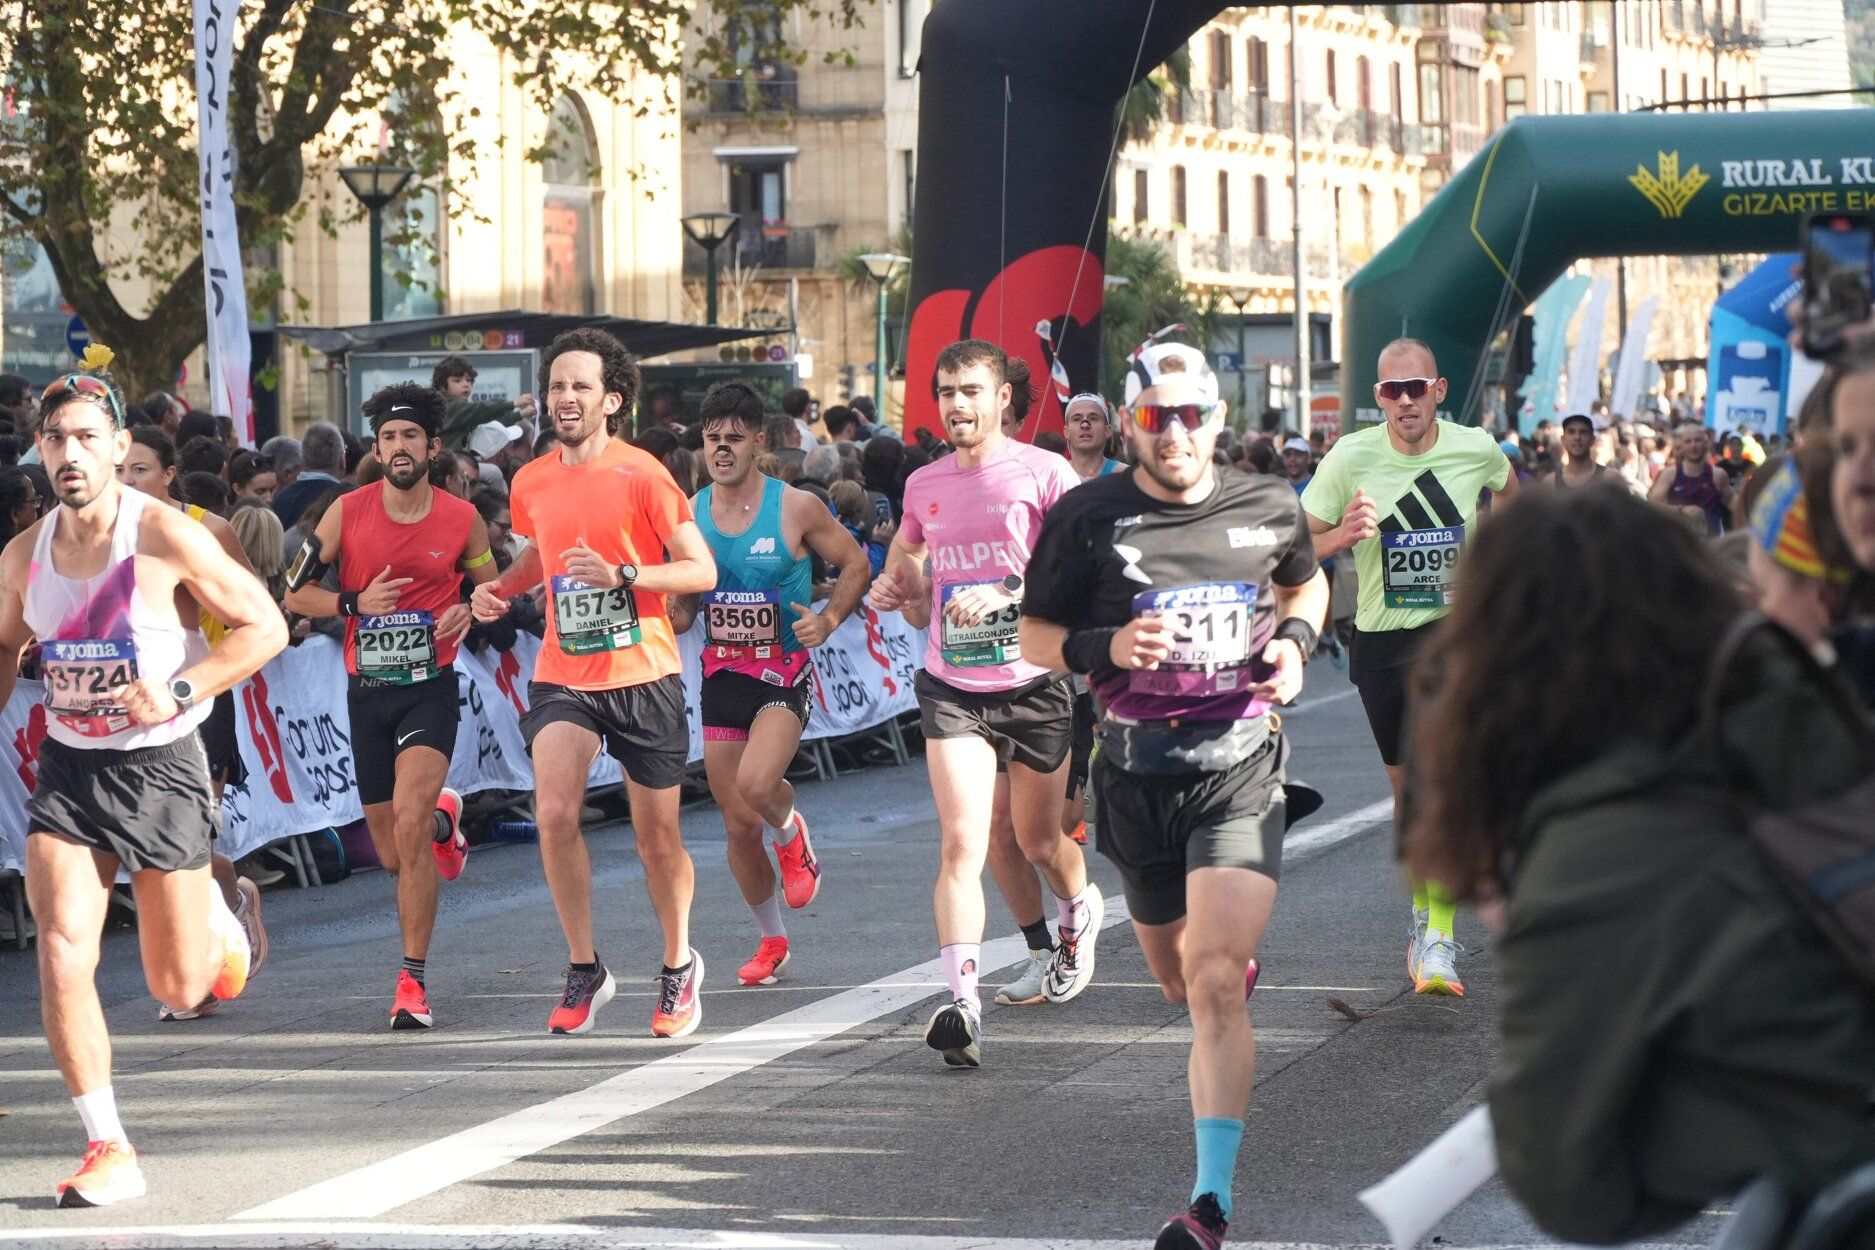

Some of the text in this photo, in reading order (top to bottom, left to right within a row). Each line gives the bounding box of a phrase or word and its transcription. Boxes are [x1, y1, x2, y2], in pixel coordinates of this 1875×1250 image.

[1721, 157, 1875, 187] RURAL KU
[1722, 190, 1875, 215] GIZARTE EK
[507, 333, 519, 345] 21
[1356, 408, 1390, 421] RURA
[1390, 547, 1459, 573] 2099
[1413, 576, 1441, 584] ARCE
[560, 588, 627, 618] 1573
[576, 618, 613, 630] DANIEL
[711, 607, 773, 629] 3560
[361, 628, 427, 652] 2022
[727, 632, 756, 640] MITXE
[380, 655, 412, 664] MIKEL
[50, 664, 129, 694] 3724
